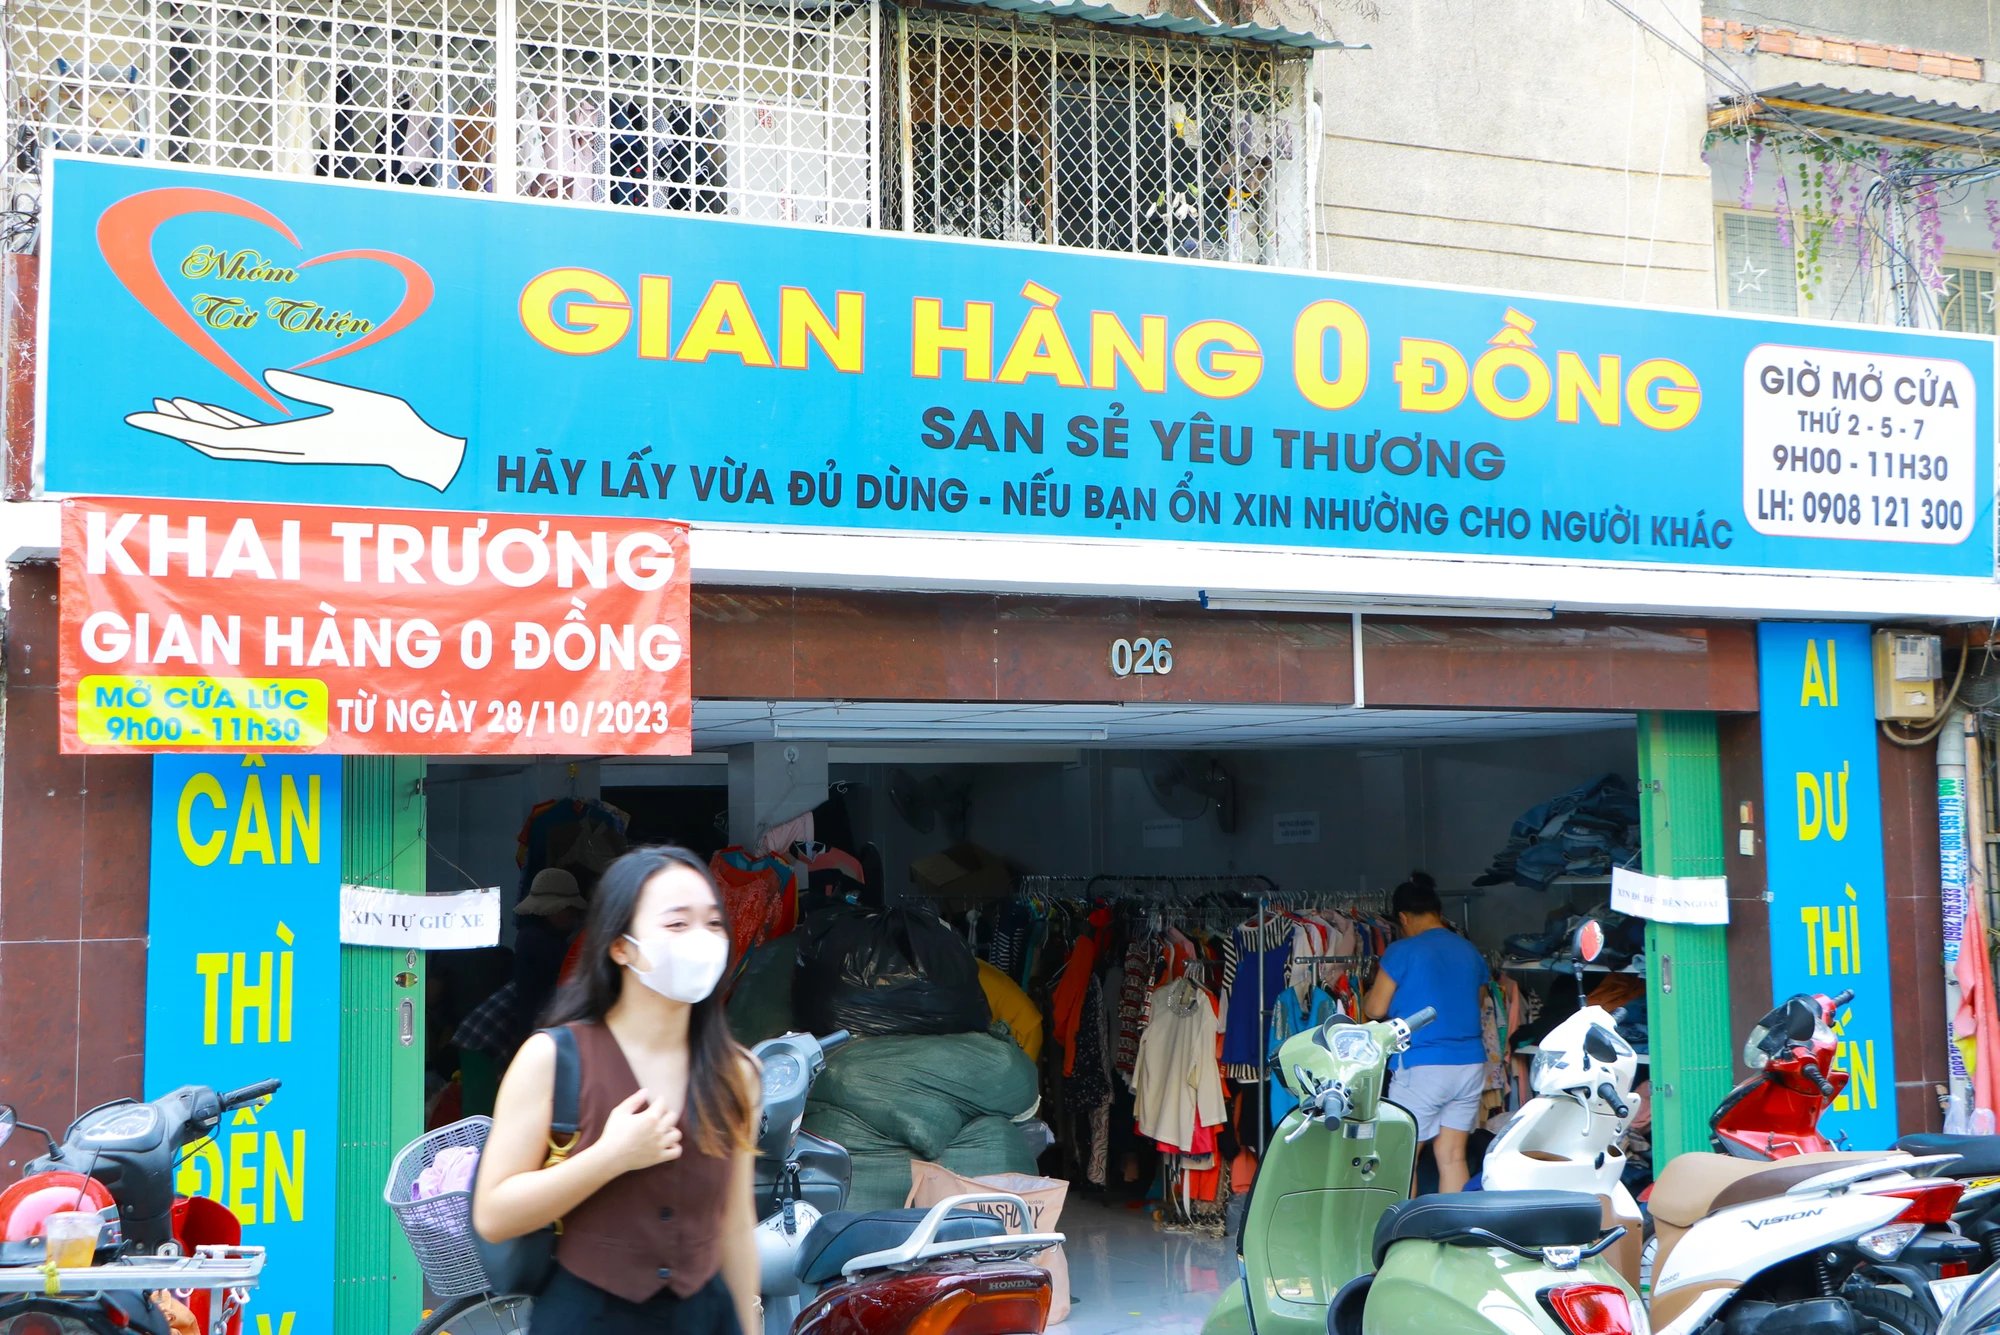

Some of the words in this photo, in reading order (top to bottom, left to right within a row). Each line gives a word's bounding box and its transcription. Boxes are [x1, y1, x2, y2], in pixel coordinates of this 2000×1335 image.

[181, 244, 299, 283] Nhóm
[192, 293, 259, 330] Từ
[265, 296, 375, 339] Thiện
[518, 266, 865, 374] GIAN
[911, 279, 1264, 400] HÀNG
[1292, 298, 1369, 411] 0
[1393, 306, 1702, 432] ĐỒNG
[1760, 359, 1821, 398] GIỜ
[1832, 363, 1883, 403] MỞ
[1894, 368, 1960, 409] CỬA
[921, 406, 1044, 454] SAN
[1066, 402, 1129, 459] SẺ
[1149, 411, 1253, 466] YÊU
[1273, 428, 1506, 480] THƯƠNG
[1797, 406, 1841, 435] THỨ
[1848, 414, 1860, 436] 2
[1880, 416, 1893, 438] 5
[1913, 419, 1925, 440] 7
[1772, 444, 1842, 475] 9H00
[1868, 451, 1948, 482] 11H30
[497, 447, 587, 496] HÃY
[601, 445, 677, 500] LẤY
[689, 455, 774, 505] VỪA
[787, 458, 842, 508] ĐỦ
[856, 464, 969, 513] DÙNG
[1002, 467, 1071, 517] NẾU
[1084, 484, 1156, 530] BẠN
[1169, 470, 1220, 524] ỔN
[1233, 493, 1291, 528] XIN
[1304, 491, 1449, 536] NHƯỜNG
[1460, 504, 1531, 540] CHO
[1542, 503, 1640, 545] NGƯỜI
[1651, 509, 1734, 550] KHÁC
[1758, 488, 1793, 522] LH:
[1803, 490, 1861, 526] 0908
[1871, 495, 1909, 528] 121
[1921, 498, 1963, 531] 300
[86, 511, 301, 581] KHAI
[331, 518, 676, 592] TRƯƠNG
[80, 610, 241, 666] GIAN
[265, 601, 442, 669] HÀNG
[460, 619, 493, 670] 0
[511, 596, 682, 673] ĐỒNG
[1111, 637, 1173, 676] 026
[95, 678, 152, 709] MỞ
[163, 680, 236, 710] CỬA
[248, 683, 309, 711] LÚC
[1800, 639, 1838, 706] AI
[106, 716, 182, 741] 9h00
[211, 717, 300, 742] 11h30
[337, 688, 378, 732] TỪ
[386, 689, 478, 734] NGÀY
[487, 699, 669, 738] 28/10/2023
[1796, 760, 1849, 841] DƯ
[351, 910, 383, 926] XIN
[389, 913, 416, 931] TỰ
[419, 912, 456, 930] GIỮ
[461, 913, 484, 928] XE
[1800, 881, 1861, 976] THÌ
[195, 920, 295, 1045] THÌ
[1829, 1007, 1877, 1112] ẾN
[176, 1094, 306, 1226] ĐẾN
[989, 1280, 1034, 1291] HONDA
